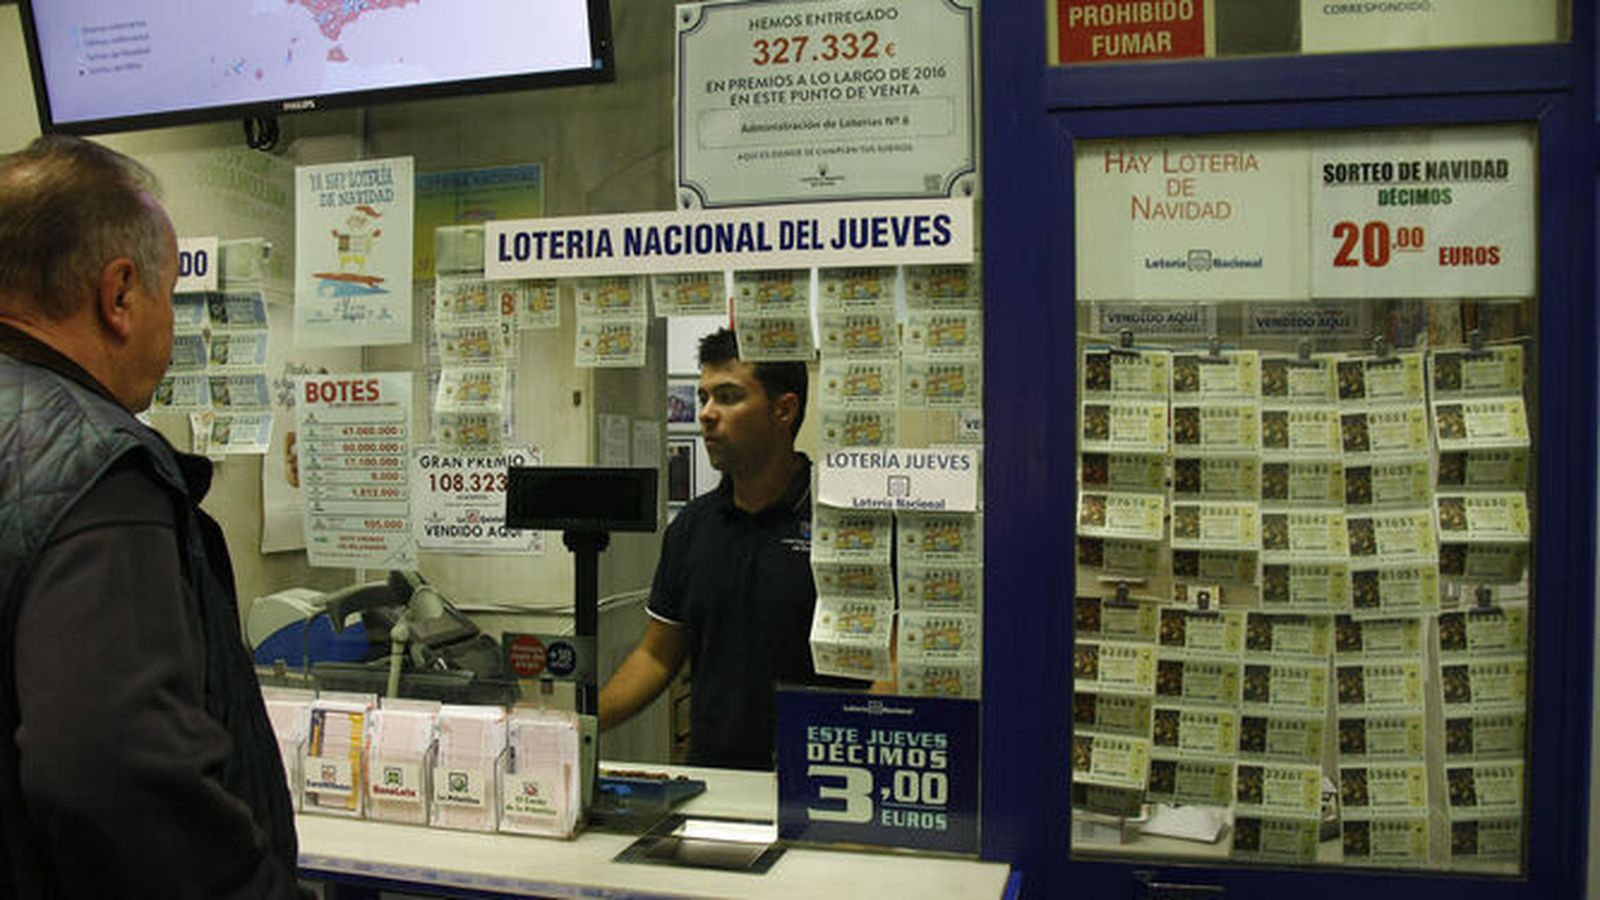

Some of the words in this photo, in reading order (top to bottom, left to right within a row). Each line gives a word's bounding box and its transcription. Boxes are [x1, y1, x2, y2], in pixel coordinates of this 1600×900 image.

[749, 14, 803, 31] HEMOS
[805, 7, 899, 27] ENTREGADO
[1069, 0, 1194, 28] PROHIBIDO
[752, 30, 880, 66] 327.332
[884, 42, 897, 58] €
[1092, 31, 1172, 57] FUMAR
[705, 80, 726, 94] EN
[728, 74, 794, 91] PREMIOS
[796, 74, 809, 88] A
[810, 73, 831, 87] LO
[833, 68, 887, 84] LARGO
[889, 67, 911, 81] DE
[914, 66, 947, 80] 2016
[730, 93, 751, 107] EN
[753, 90, 788, 106] ESTE
[790, 88, 842, 103] PUNTO
[845, 86, 868, 101] DE
[868, 83, 920, 99] VENTA
[822, 117, 837, 130] de
[1104, 150, 1153, 174] HAY
[1322, 162, 1394, 184] SORTEO
[1399, 161, 1421, 182] DE
[1425, 158, 1510, 181] NAVIDAD
[1166, 177, 1195, 198] DE
[1130, 195, 1232, 220] NAVIDAD
[498, 228, 614, 263] LOTERIA
[623, 221, 773, 258] NACIONAL
[779, 218, 824, 251] DEL
[830, 213, 953, 250] JUEVES
[1212, 256, 1263, 269] Nacional
[1438, 246, 1501, 267] EUROS
[305, 379, 380, 403] BOTES
[419, 454, 462, 470] GRAN
[905, 453, 970, 470] JUEVES
[429, 473, 509, 493] 108.323
[424, 524, 483, 538] VENDIDO
[807, 726, 859, 743] ESTE
[867, 729, 948, 748] JUEVES
[881, 809, 948, 831] EUROS
